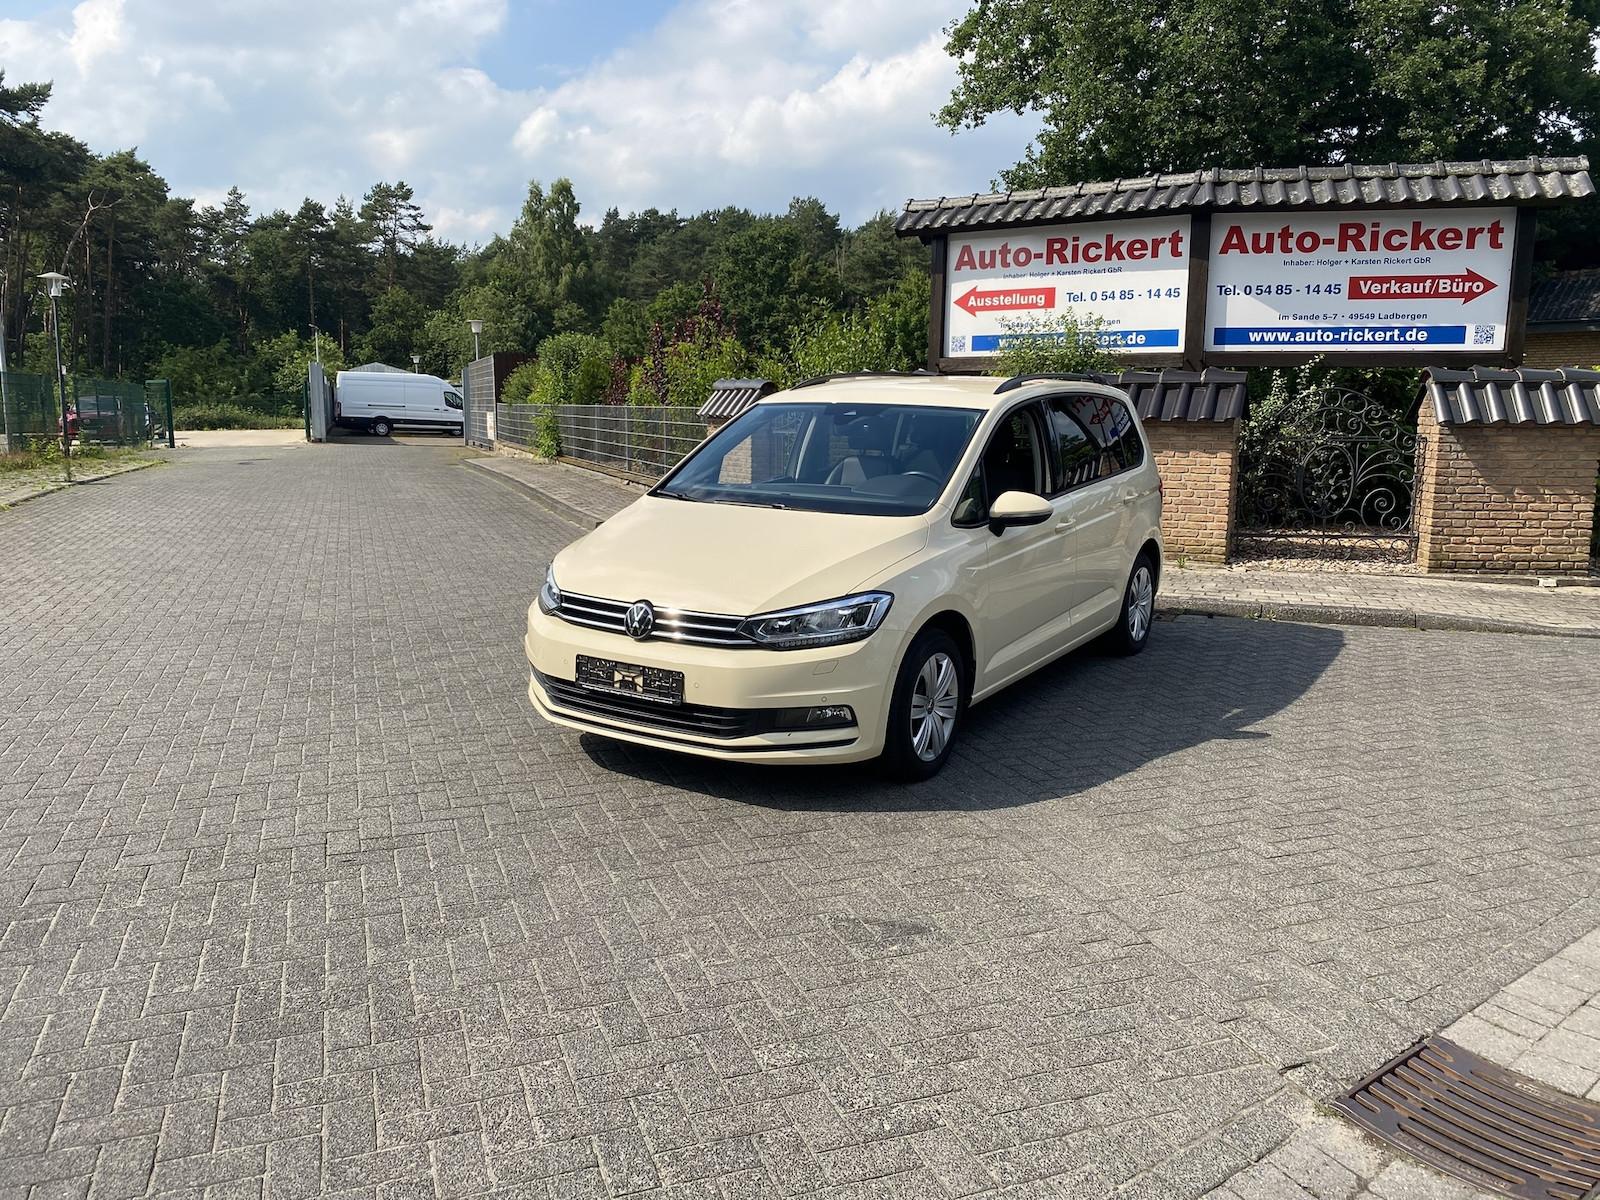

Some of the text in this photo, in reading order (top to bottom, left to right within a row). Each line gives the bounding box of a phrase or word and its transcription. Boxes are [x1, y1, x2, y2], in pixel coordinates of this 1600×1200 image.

[1218, 219, 1505, 254] Auto-Rickert
[954, 229, 1183, 271] Auto-Rickert
[1283, 259, 1315, 267] Inhaber:
[1317, 259, 1342, 268] Holger
[1029, 271, 1050, 279] Holger
[1217, 285, 1240, 295] Tel.
[1244, 285, 1252, 295] 0
[1255, 285, 1272, 295] 54
[1275, 285, 1292, 295] 85
[1305, 284, 1320, 295] 14
[1324, 284, 1341, 294] 45
[1359, 279, 1484, 294] Verkauf/Büro
[967, 292, 1045, 307] Ausstellung
[1066, 292, 1086, 302] Tel.
[1090, 291, 1097, 301] 0
[1101, 290, 1115, 301] 54
[1119, 290, 1134, 300] 85
[1147, 289, 1161, 299] 14
[1165, 288, 1180, 298] 45
[1378, 312, 1428, 321] Ladbergen
[1248, 328, 1428, 342] www.auto-rickert.de
